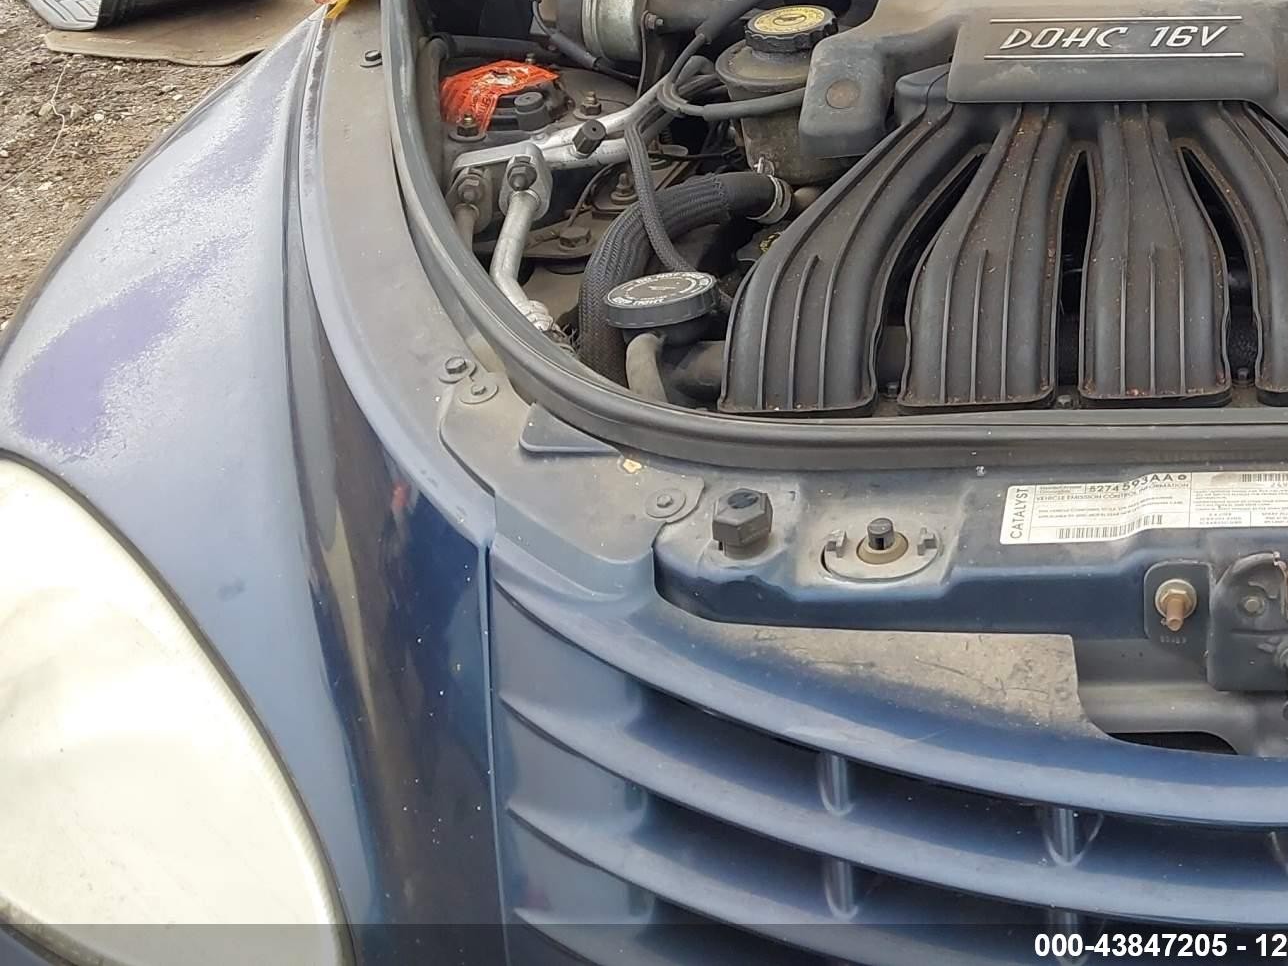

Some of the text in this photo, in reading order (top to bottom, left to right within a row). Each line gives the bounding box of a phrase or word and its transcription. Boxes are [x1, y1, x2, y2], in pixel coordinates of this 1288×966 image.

[1000, 25, 1228, 50] DOHC 16V
[1010, 488, 1028, 539] CATALYST
